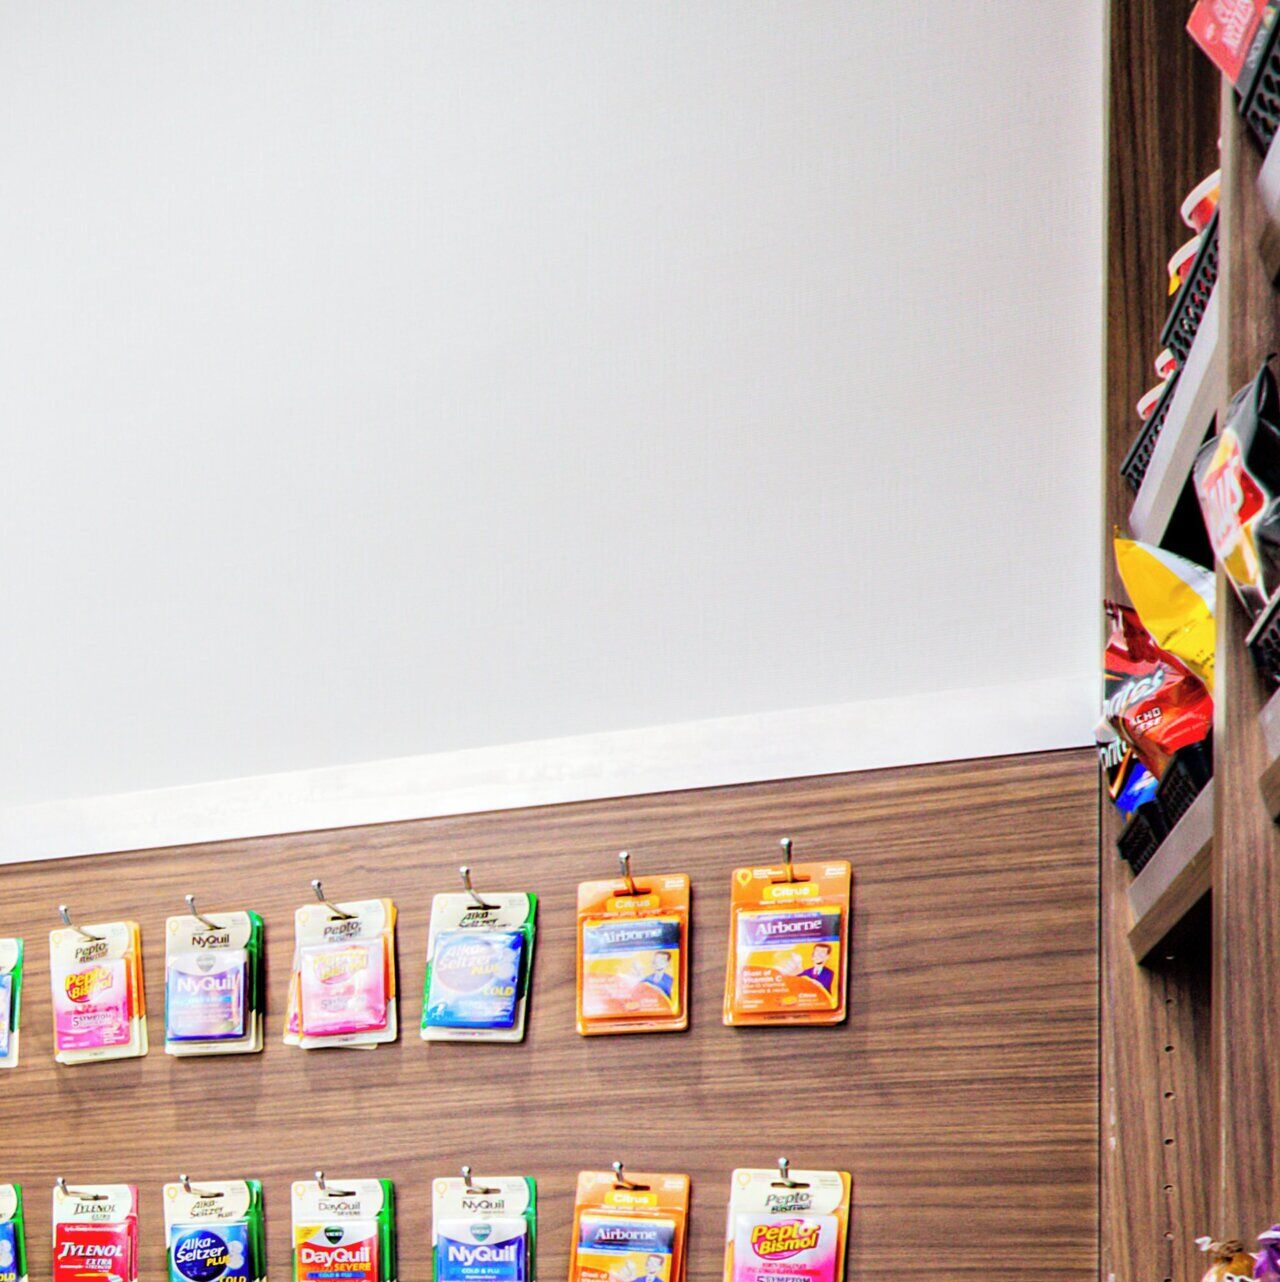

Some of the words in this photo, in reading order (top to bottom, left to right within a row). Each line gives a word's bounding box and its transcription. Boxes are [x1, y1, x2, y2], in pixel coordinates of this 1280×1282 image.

[771, 885, 810, 897] Citrus
[755, 919, 822, 936] Airborne
[192, 934, 230, 948] NyQuil
[600, 928, 662, 944] Airborne
[178, 976, 235, 994] NyQuil
[462, 1199, 505, 1212] NyQuil
[613, 1193, 649, 1204] Citrus
[74, 1203, 116, 1215] TYLENOL
[318, 1201, 360, 1213] DayQuil
[594, 1227, 657, 1241] Airborne
[58, 1241, 123, 1260] TYLENOL
[182, 1237, 216, 1251] Alka-
[759, 1233, 817, 1255] Bismol
[176, 1246, 225, 1264] Seltzer
[301, 1246, 372, 1267] DayQuil
[448, 1245, 517, 1265] NyQuil
[334, 1262, 371, 1272] SEVERE
